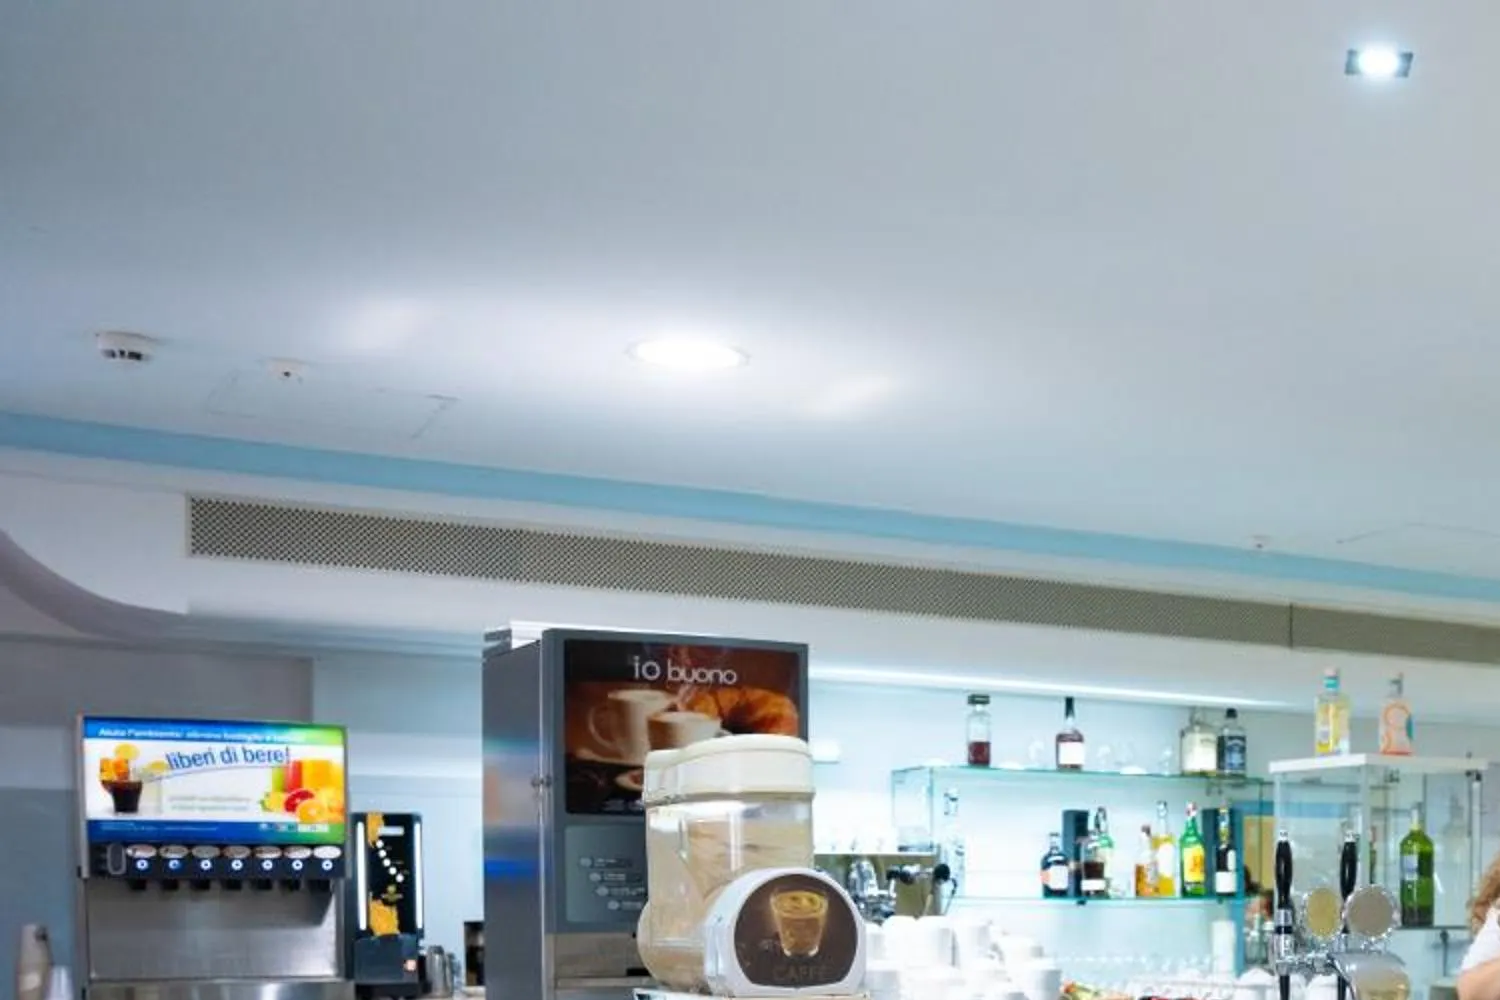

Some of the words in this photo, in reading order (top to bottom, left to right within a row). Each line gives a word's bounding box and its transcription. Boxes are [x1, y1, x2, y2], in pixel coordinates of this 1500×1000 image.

[633, 655, 660, 680] io
[667, 658, 737, 685] buono
[165, 746, 214, 769] liberi
[220, 746, 239, 765] di
[241, 746, 290, 765] bere!
